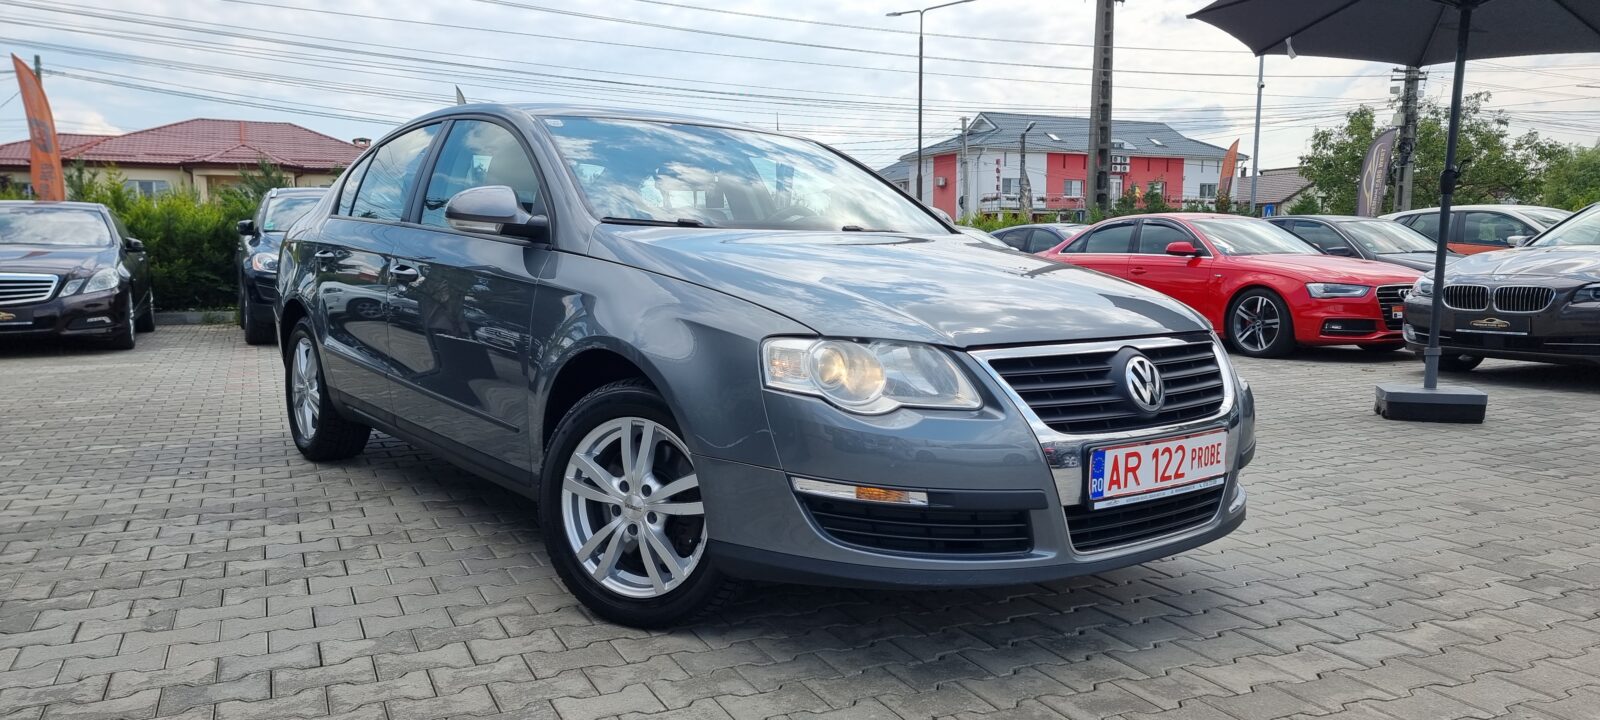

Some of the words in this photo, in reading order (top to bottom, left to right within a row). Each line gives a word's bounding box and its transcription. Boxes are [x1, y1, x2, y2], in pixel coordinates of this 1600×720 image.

[1107, 451, 1142, 491] AR
[1152, 444, 1186, 483] 122
[1190, 443, 1222, 471] PROBE
[1092, 478, 1103, 493] RO
